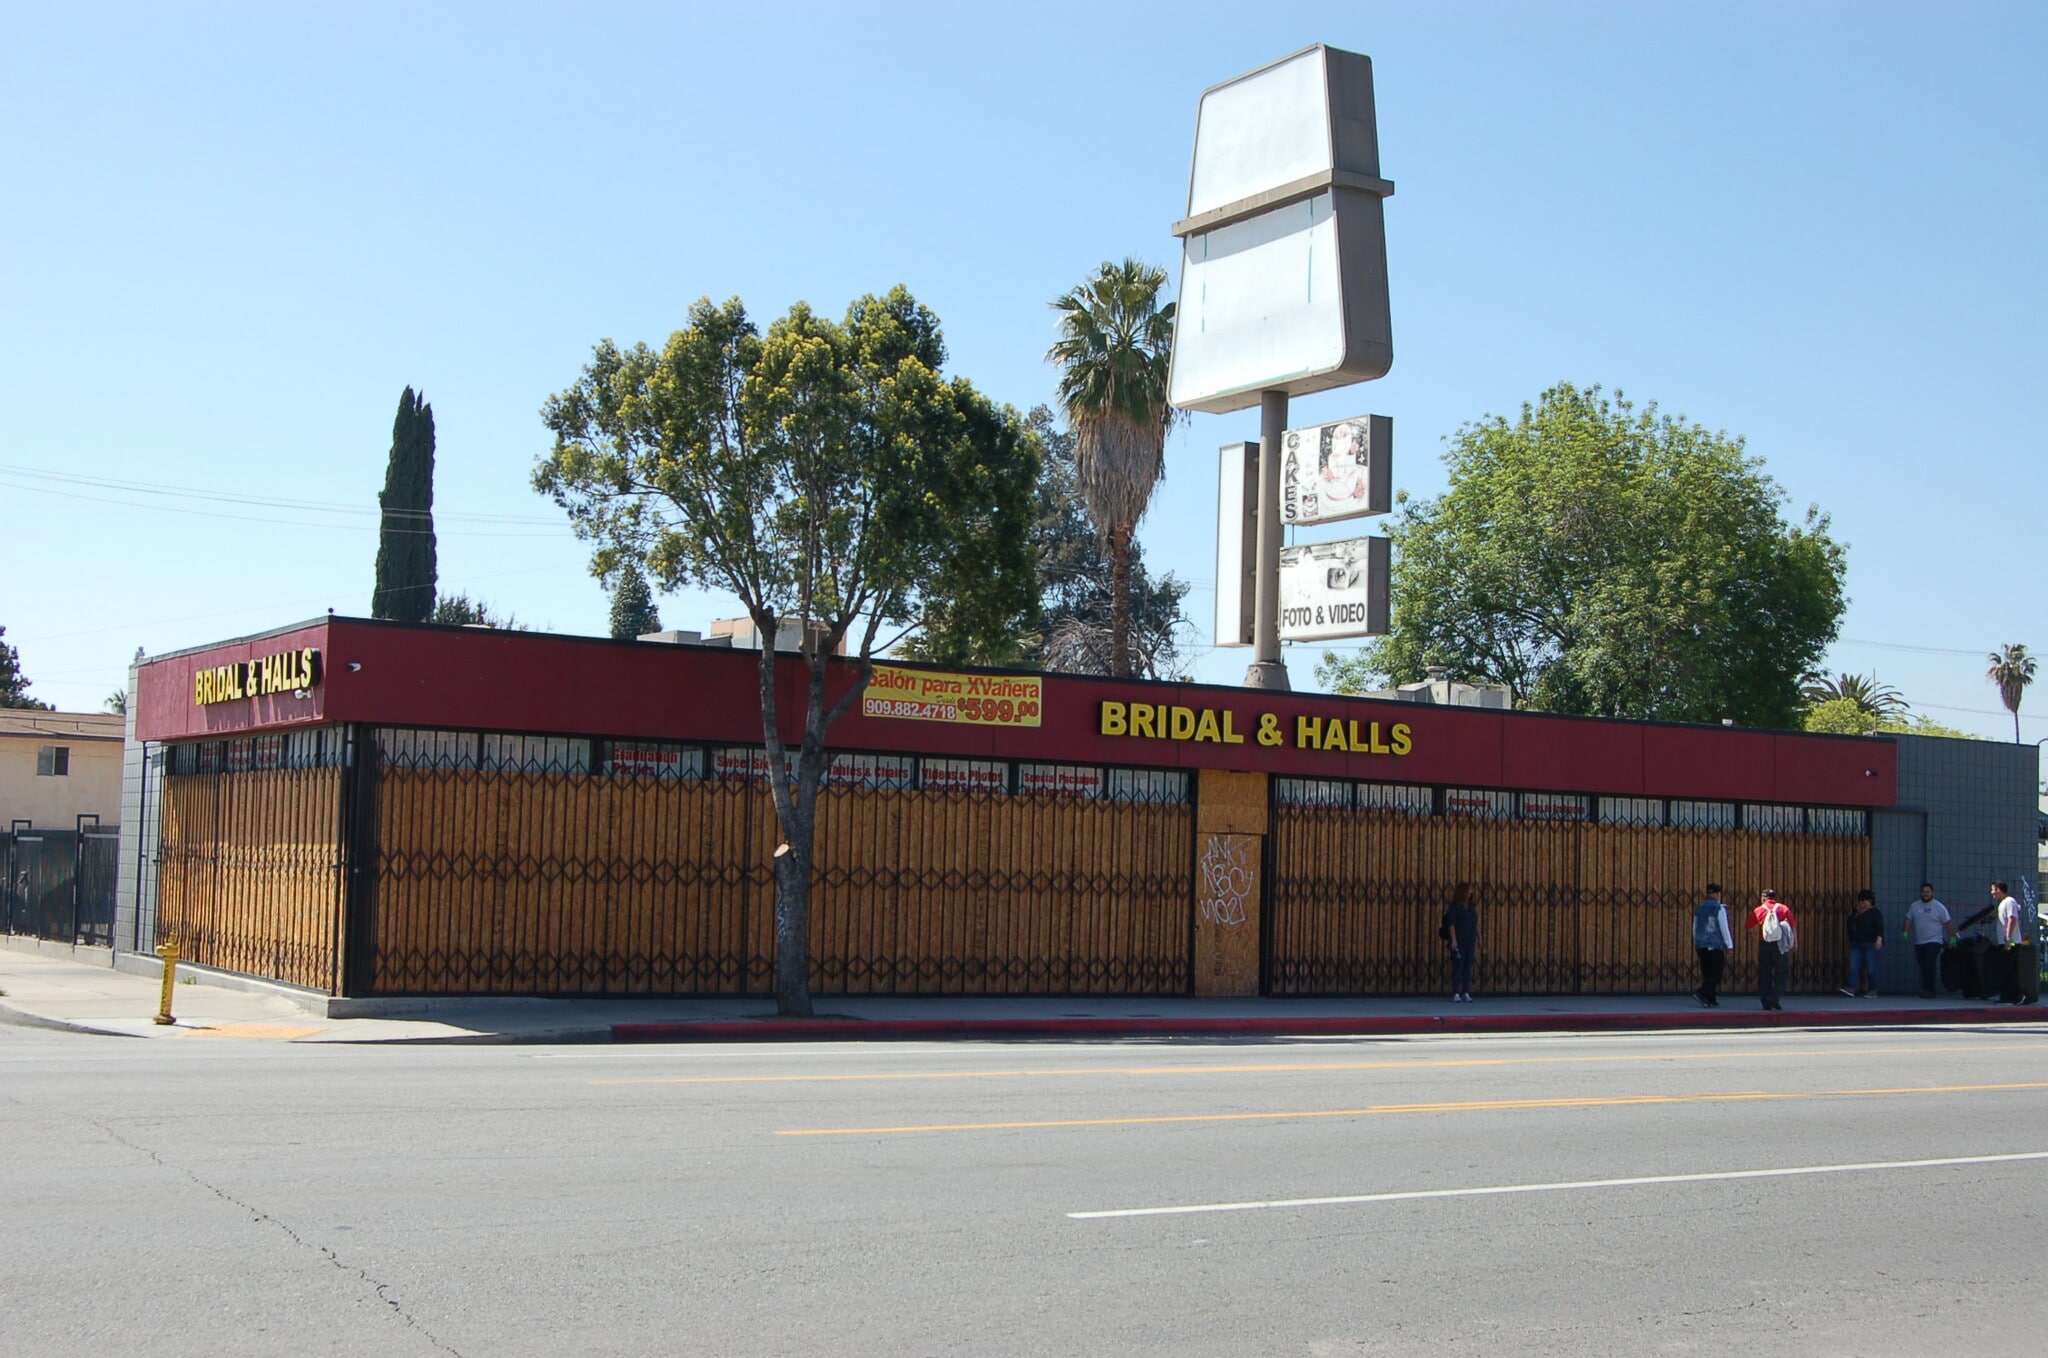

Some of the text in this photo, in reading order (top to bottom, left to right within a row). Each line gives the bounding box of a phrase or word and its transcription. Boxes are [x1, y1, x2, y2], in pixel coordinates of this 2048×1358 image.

[1284, 433, 1301, 521] CAKES
[1282, 602, 1365, 628] FOTO & VIDEO
[195, 647, 313, 705] BRIDAL & HALLS
[869, 668, 1040, 699] Salón para XVañera
[866, 699, 957, 720] 909.882.4718
[1101, 700, 1413, 756] BRIDAL & HALLS
[828, 763, 862, 777] Tables
